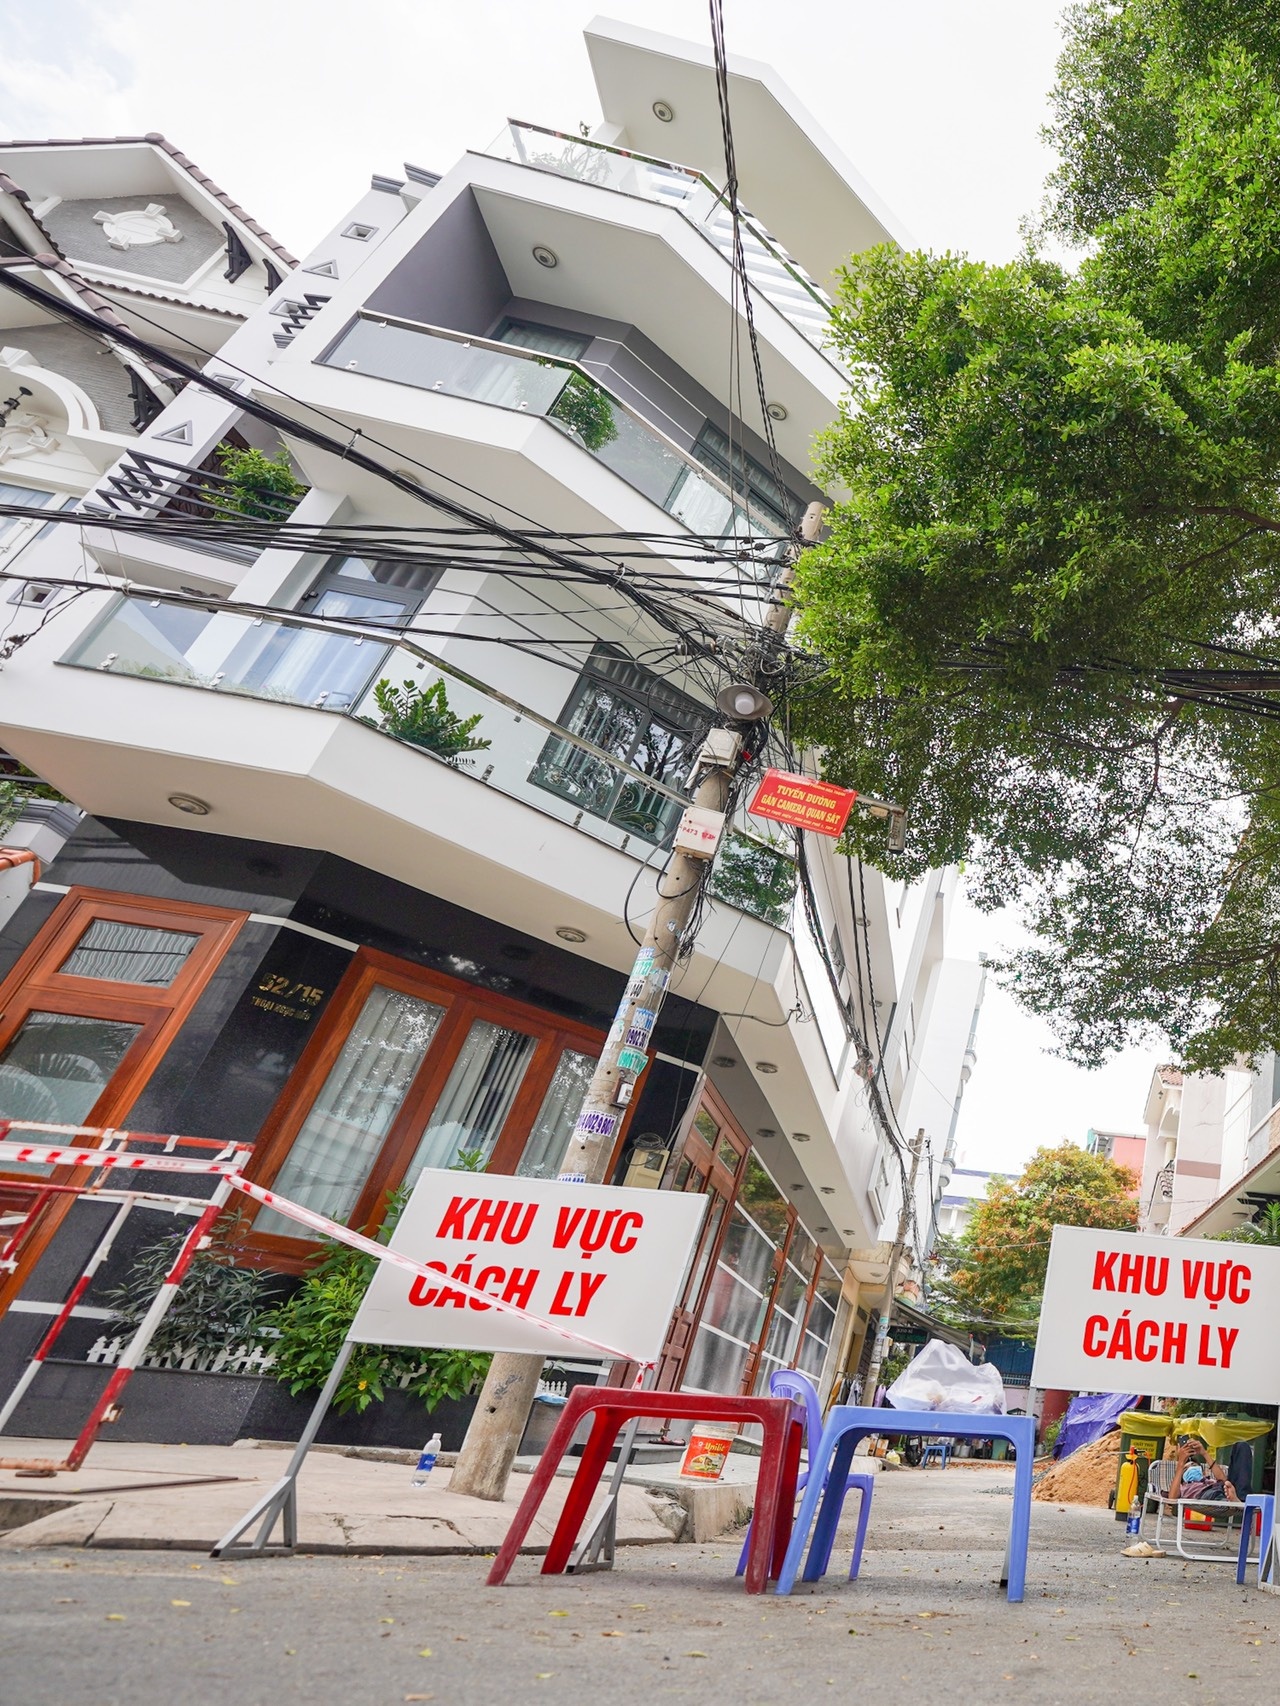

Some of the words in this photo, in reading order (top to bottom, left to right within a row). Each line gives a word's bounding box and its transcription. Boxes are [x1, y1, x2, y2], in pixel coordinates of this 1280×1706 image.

[761, 792, 777, 806] GẮN
[777, 799, 806, 815] CAMERA
[807, 807, 826, 821] QUAN
[825, 811, 841, 825] SÁT
[777, 784, 806, 801] TUYẾN
[806, 792, 836, 809] ĐƯỜNG
[259, 973, 325, 1006] 52/15
[436, 1196, 539, 1245] KHU
[552, 1206, 644, 1260] VỰC
[408, 1253, 540, 1312] CÁCH
[549, 1271, 607, 1317] LY
[1092, 1250, 1170, 1297] KHU
[1182, 1259, 1252, 1310] VỰC
[1083, 1309, 1188, 1364] CÁCH
[1198, 1324, 1240, 1369] LY
